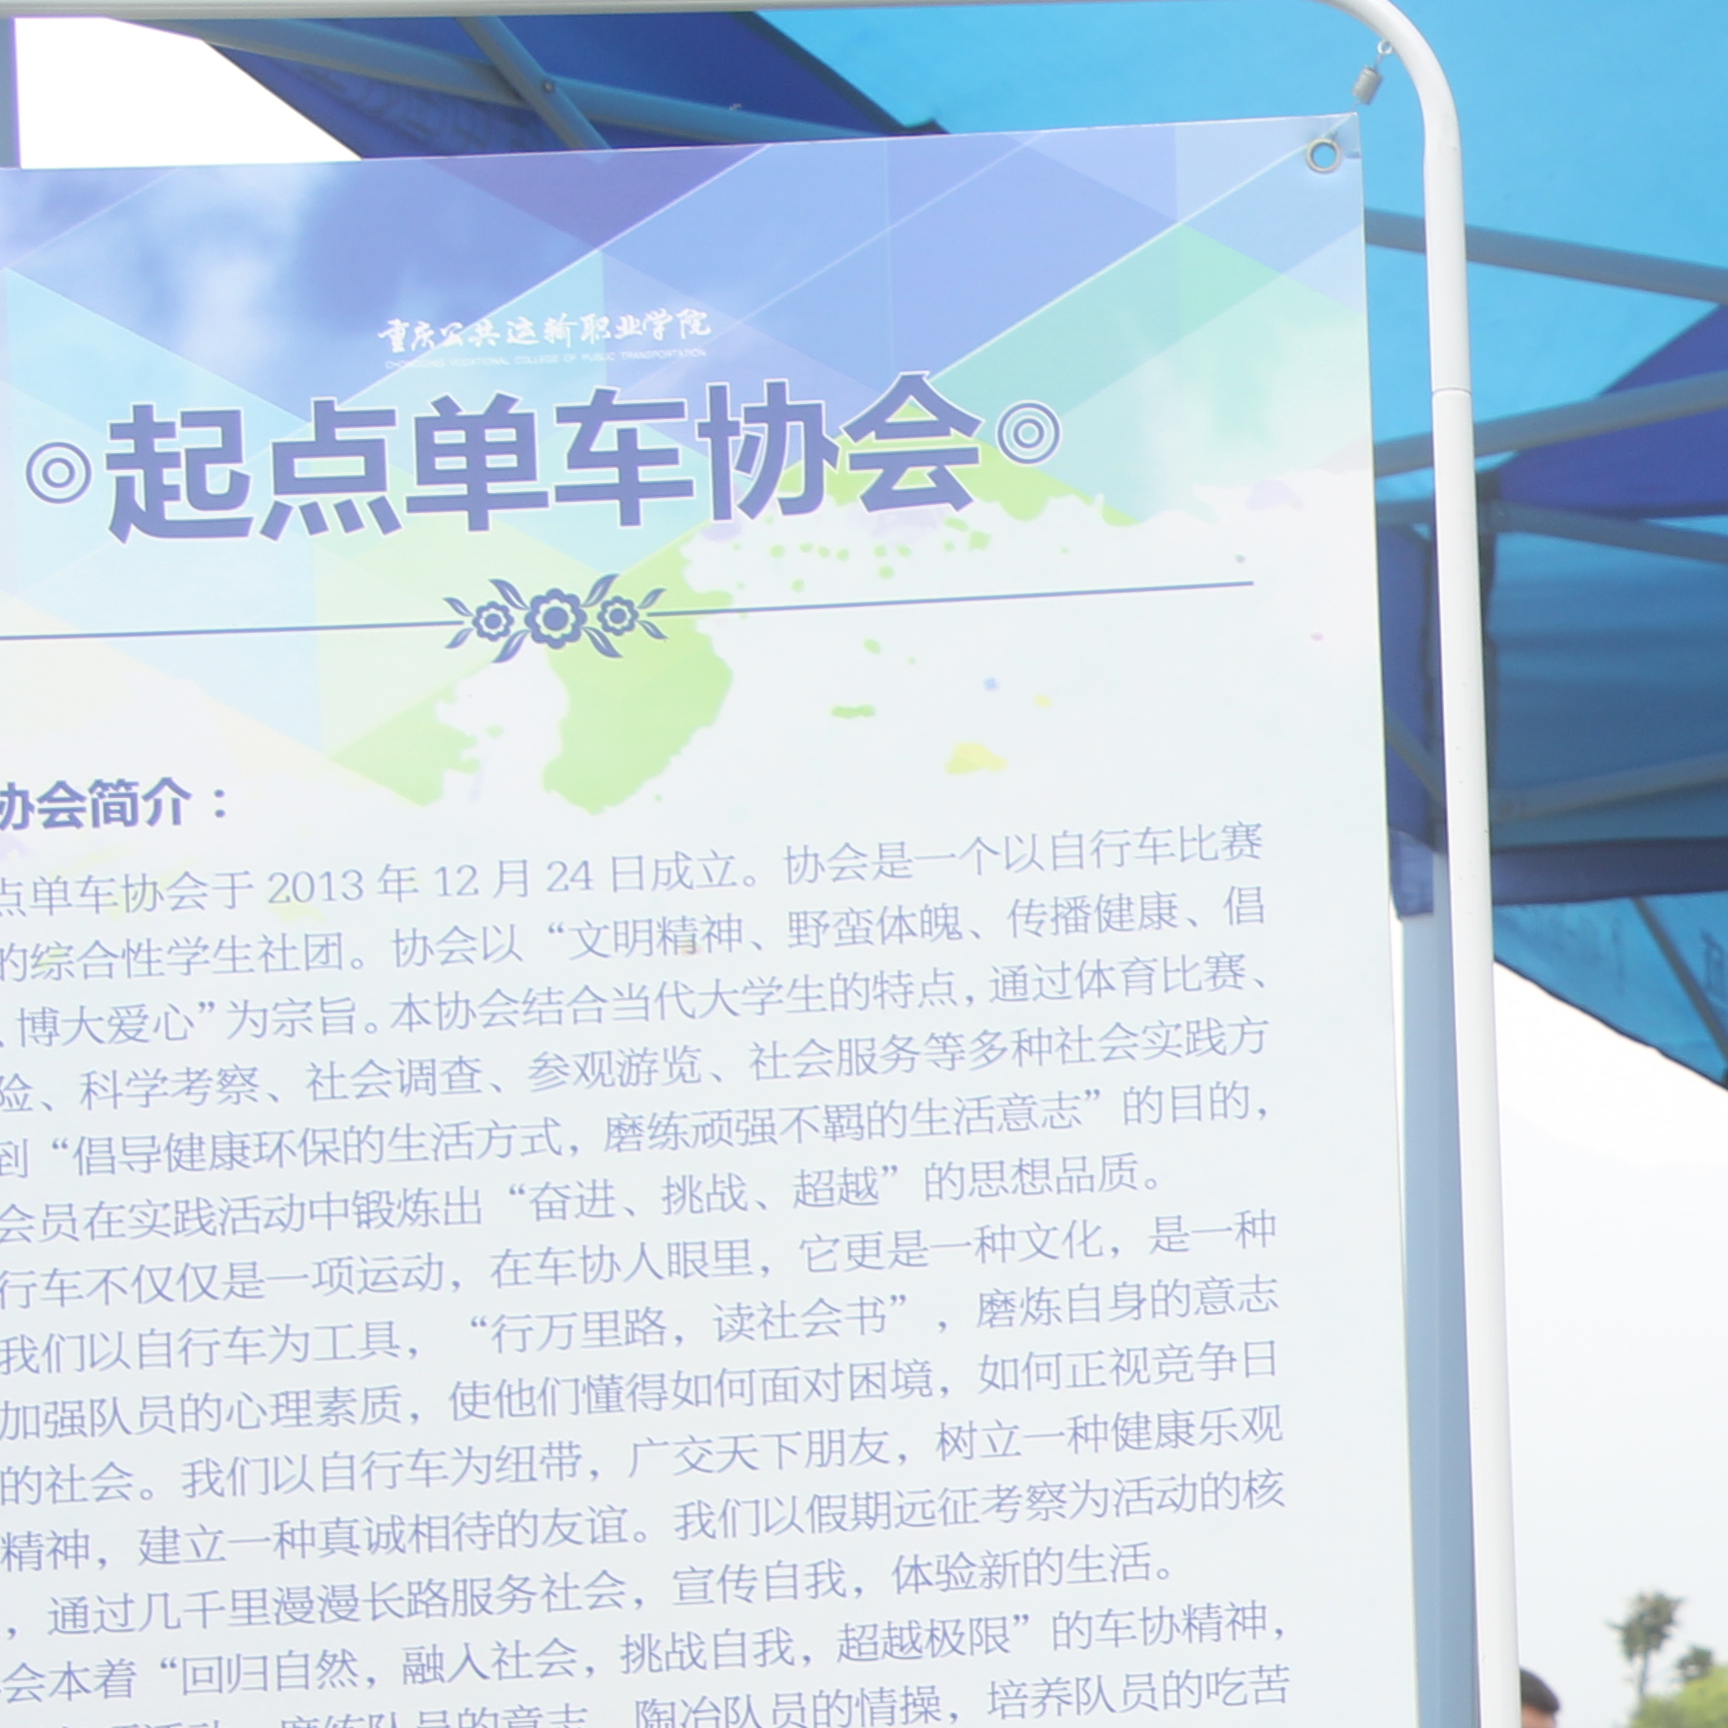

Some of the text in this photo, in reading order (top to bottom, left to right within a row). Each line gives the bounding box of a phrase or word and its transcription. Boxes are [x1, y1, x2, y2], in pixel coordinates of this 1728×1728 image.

[378, 308, 712, 353] 重庆公共运输职业学院
[564, 353, 577, 363] OF
[104, 371, 984, 545] 起点单车协会
[0, 1154, 1157, 1242] 会员在实践活动中锻炼出“奋进、挑战、超越”的思想品质。
[0, 1211, 1276, 1308] 行车不仅仅是一项运动，在车协人眼里，它更是一种文化，是一种
[0, 1342, 1275, 1439] 加强队员的心理素质，使他们懂得如何面对困境，如何正视竞争日
[0, 1406, 1283, 1504] 的社会。我们以自行车为纽带，广交天下朋友，树立一种健康乐观
[0, 1471, 1285, 1570] 精神，建立一种真诚相待的友谊。我们以假期远征考察为活动的核
[0, 1543, 1169, 1635] ，通过几千里漫漫长路服务社会，宣传自我，体验新的生活。
[0, 1603, 1283, 1702] 会本着“回归自然，融入社会，挑战自我，超越极限”的车协精神，
